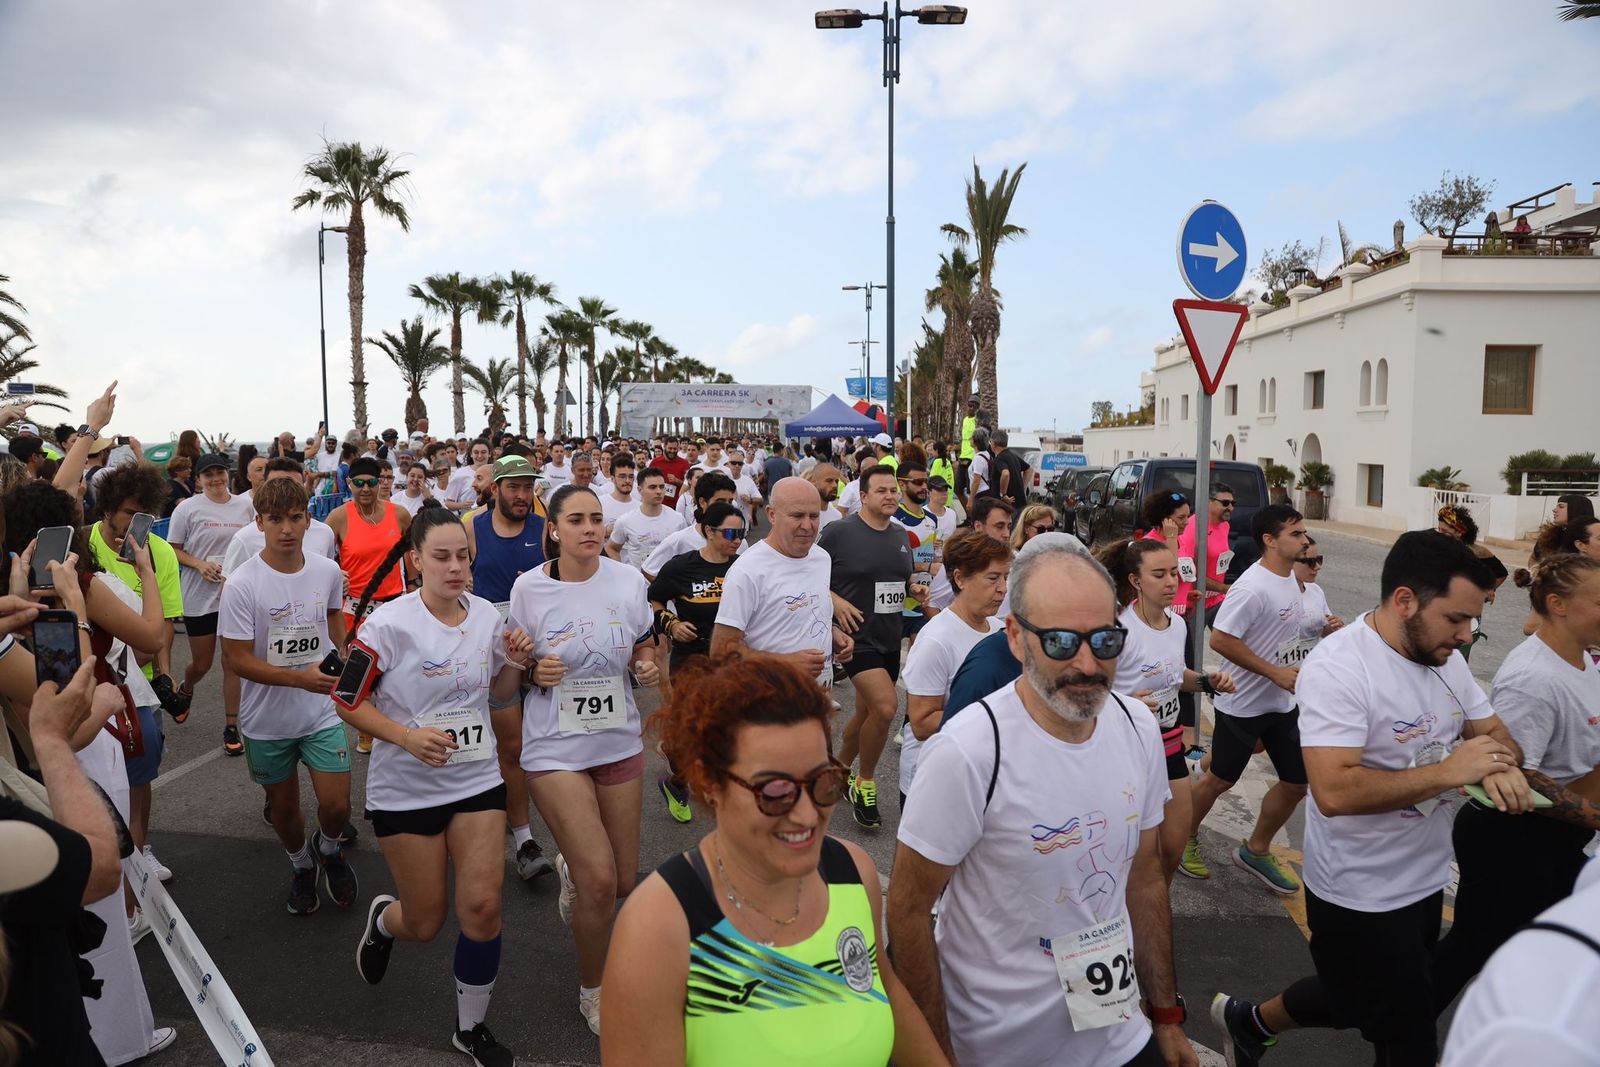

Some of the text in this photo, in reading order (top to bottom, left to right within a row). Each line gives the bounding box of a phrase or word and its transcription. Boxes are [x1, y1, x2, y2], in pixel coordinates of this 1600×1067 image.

[681, 389, 693, 397] 3A
[694, 389, 737, 397] CARRERA
[878, 593, 905, 605] 1309
[351, 602, 374, 615] 53
[273, 636, 320, 655] 1280
[572, 694, 614, 716] 791
[1078, 933, 1090, 942] 3A
